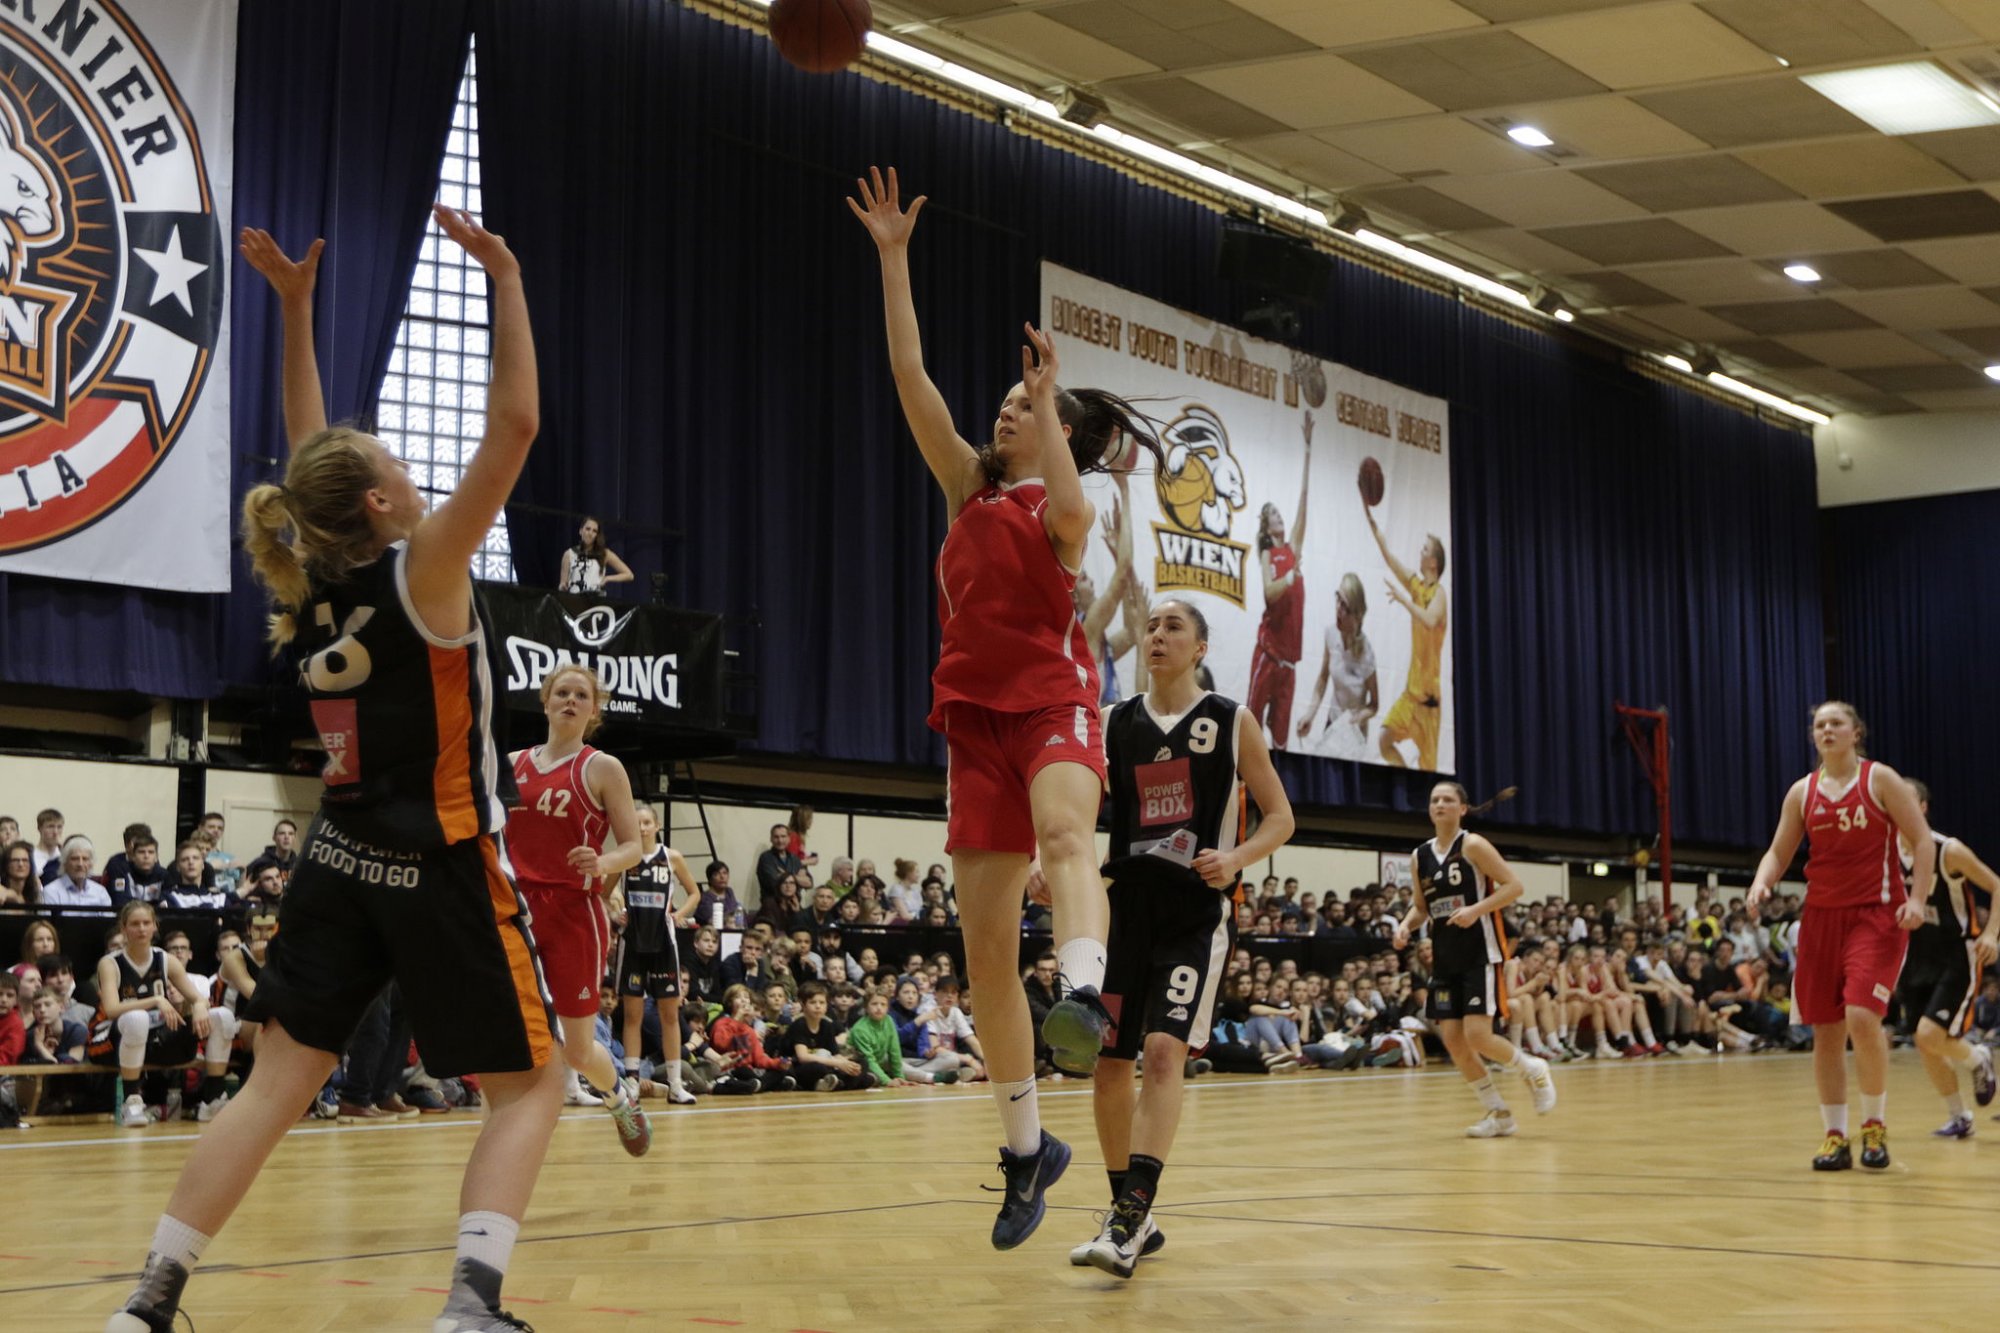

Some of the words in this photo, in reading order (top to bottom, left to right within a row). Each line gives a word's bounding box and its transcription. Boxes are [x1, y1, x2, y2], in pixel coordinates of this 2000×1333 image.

[1052, 295, 1121, 352] BIGGEST
[1127, 321, 1177, 370] YOUTH
[1184, 340, 1277, 402] TOURNAMENT
[1336, 391, 1391, 438] CENTRAL
[1395, 410, 1441, 454] EUROPE
[1158, 530, 1243, 580] WIEN
[1159, 562, 1243, 598] BASKETBALL
[610, 700, 638, 713] GAME
[1188, 717, 1219, 754] 9
[536, 787, 572, 818] 42
[1144, 781, 1185, 799] POWER
[1146, 793, 1188, 819] BOX
[1836, 804, 1868, 831] 34
[309, 840, 357, 875] FOOD
[359, 859, 384, 884] TO
[386, 865, 420, 888] GO
[1448, 862, 1462, 886] 5
[1166, 965, 1199, 1004] 9
